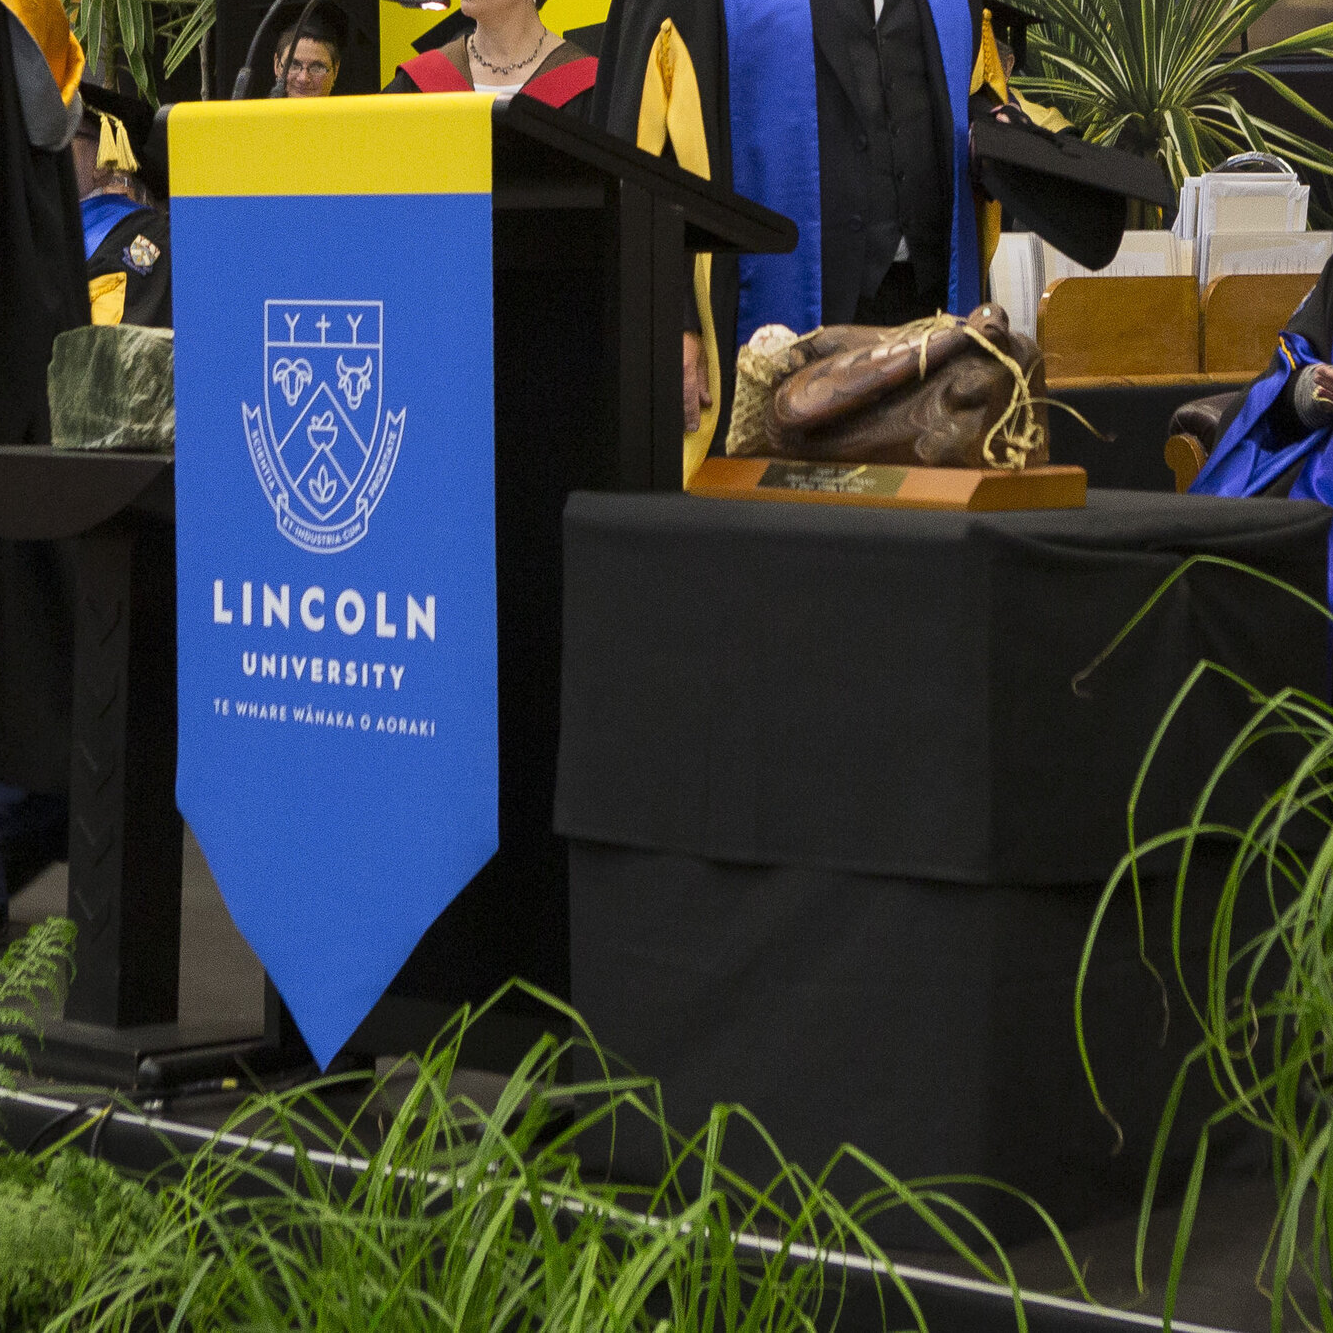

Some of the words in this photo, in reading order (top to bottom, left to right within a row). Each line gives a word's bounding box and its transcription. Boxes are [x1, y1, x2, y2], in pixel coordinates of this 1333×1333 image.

[214, 579, 436, 642] LINCOLN
[243, 652, 406, 692] UNIVERSITY
[213, 698, 229, 716] TE
[235, 700, 287, 722] WHARE
[360, 713, 371, 731] O
[376, 715, 436, 737] AORAKI
